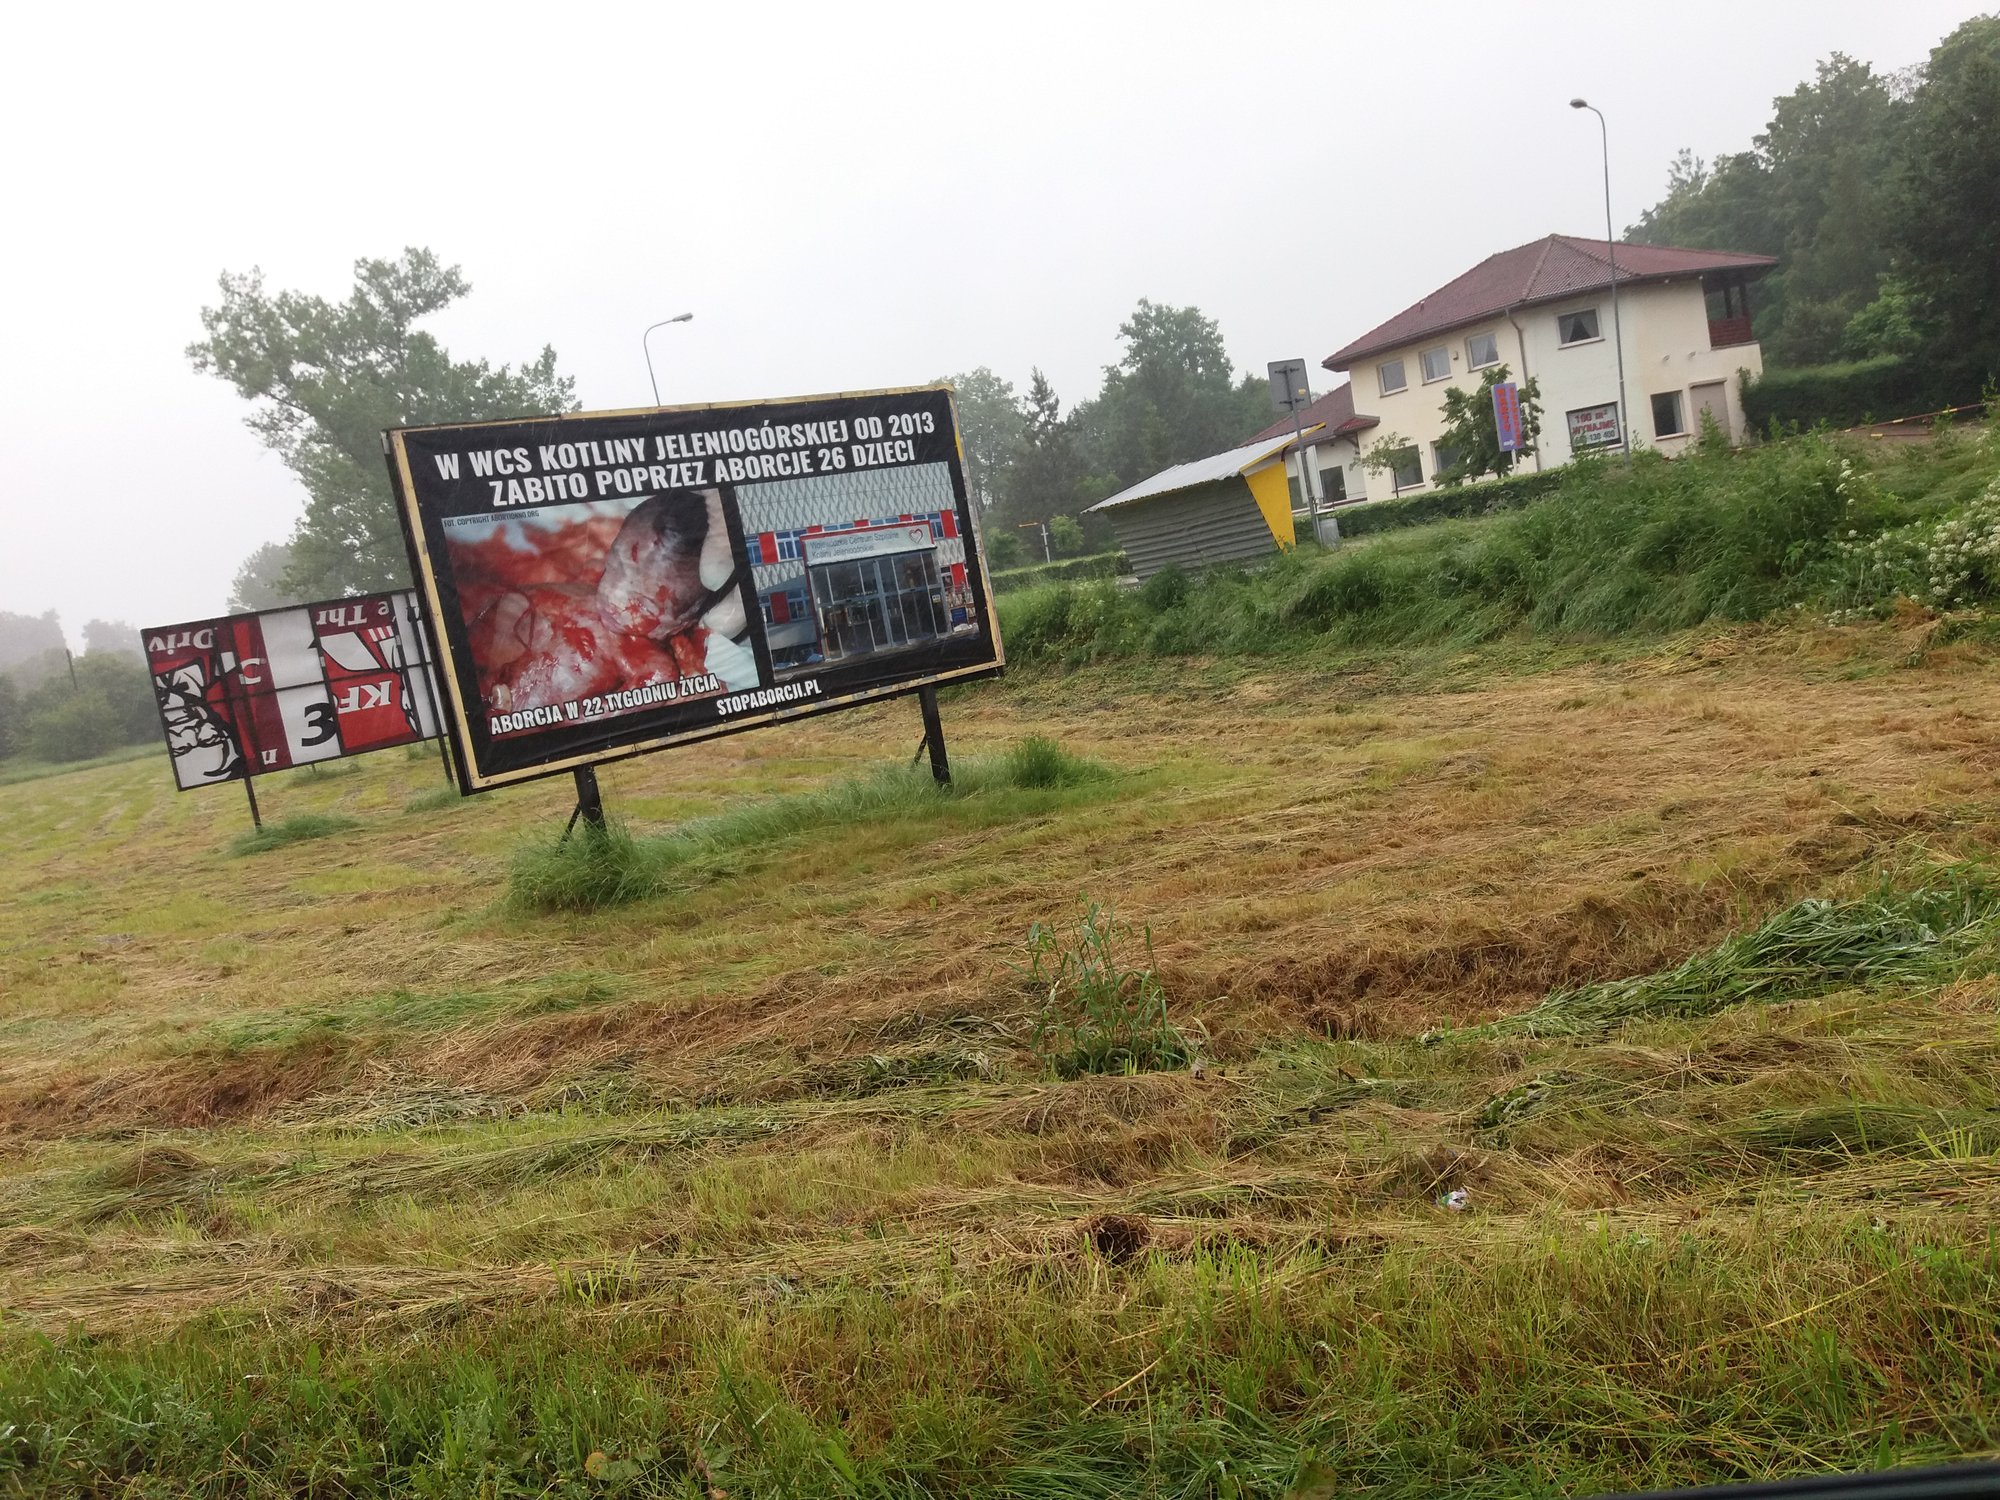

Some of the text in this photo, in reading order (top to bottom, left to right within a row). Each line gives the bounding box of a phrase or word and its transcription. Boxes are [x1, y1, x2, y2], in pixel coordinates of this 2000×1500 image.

[434, 411, 935, 480] W WCS KOTLINY JELENIOGÓRSKIEJ OD 2013
[488, 439, 916, 507] ZABITO POPRZEZ ABORCJE 26 DZIECI
[457, 515, 490, 527] COPYRIGHT
[333, 680, 392, 714] KF
[490, 672, 720, 735] ABORCJA W 22 TYGODNIU ŻYCIA
[716, 679, 823, 716] STOPABORCJI.PL
